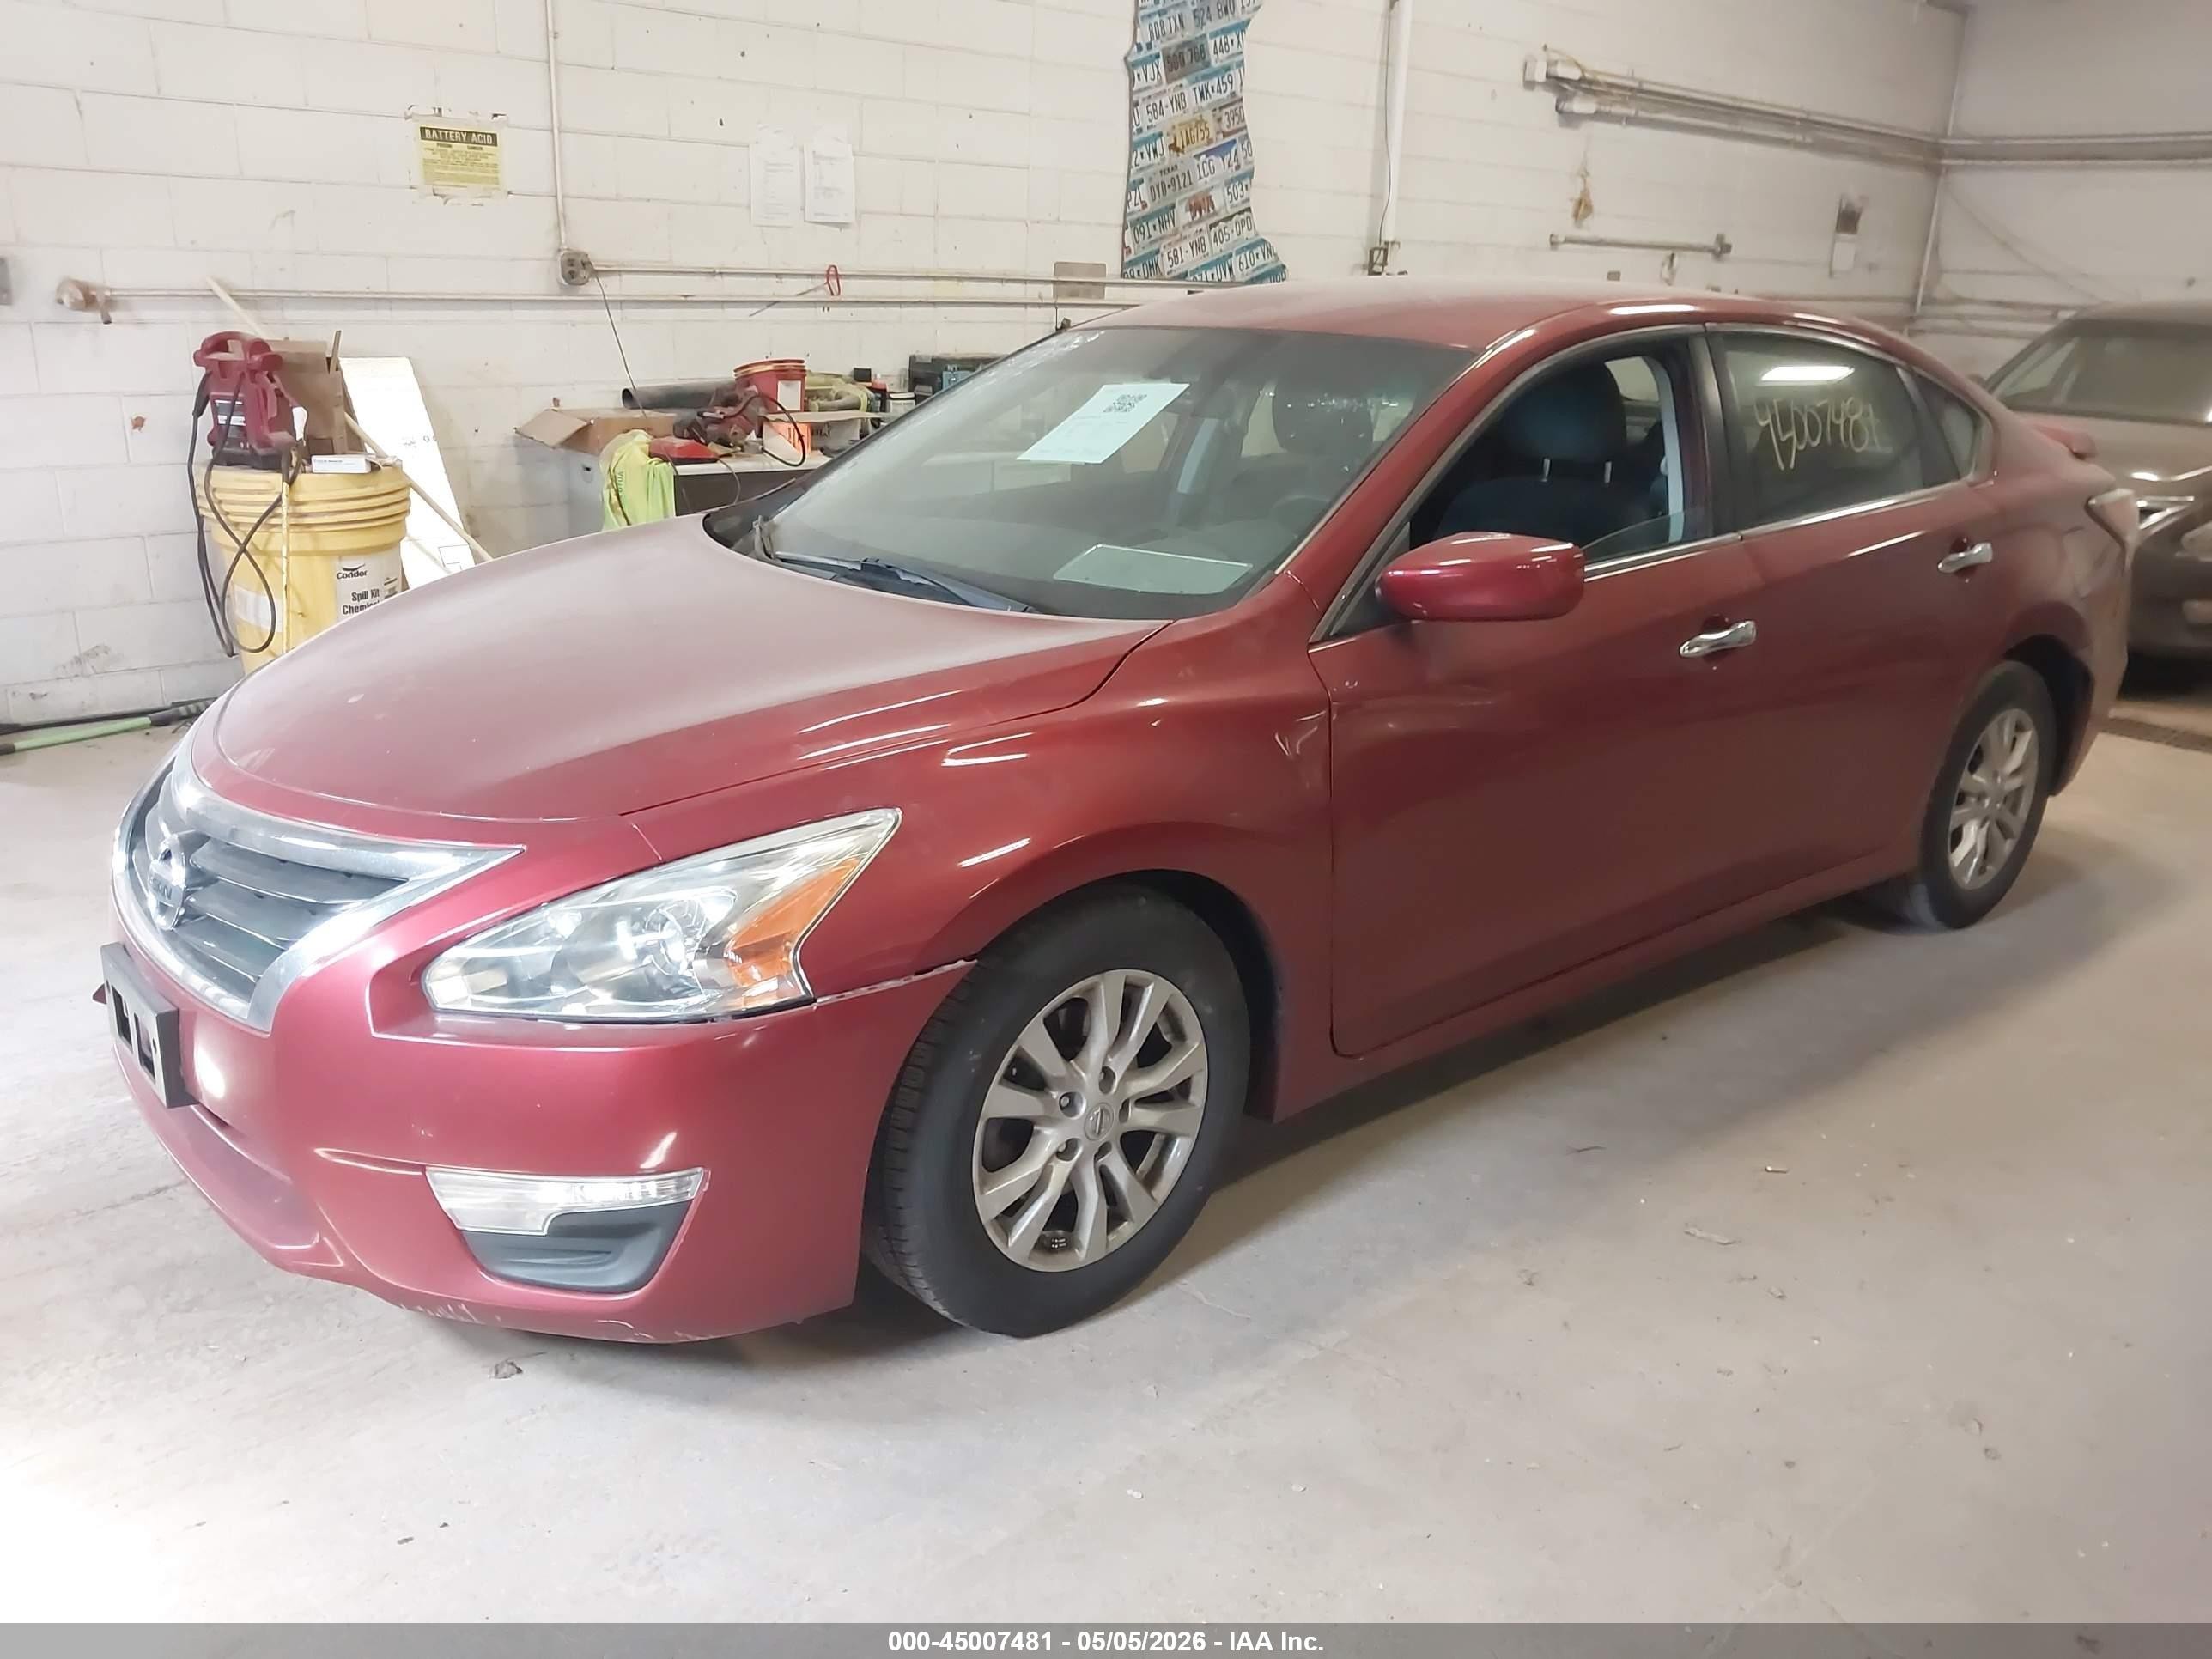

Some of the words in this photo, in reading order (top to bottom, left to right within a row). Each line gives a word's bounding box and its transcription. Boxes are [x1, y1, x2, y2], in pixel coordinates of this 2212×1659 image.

[425, 128, 467, 142] BATTERY
[471, 132, 493, 145] ACID
[336, 570, 368, 580] Condor
[351, 590, 369, 602] Spill
[371, 588, 380, 599] Kit
